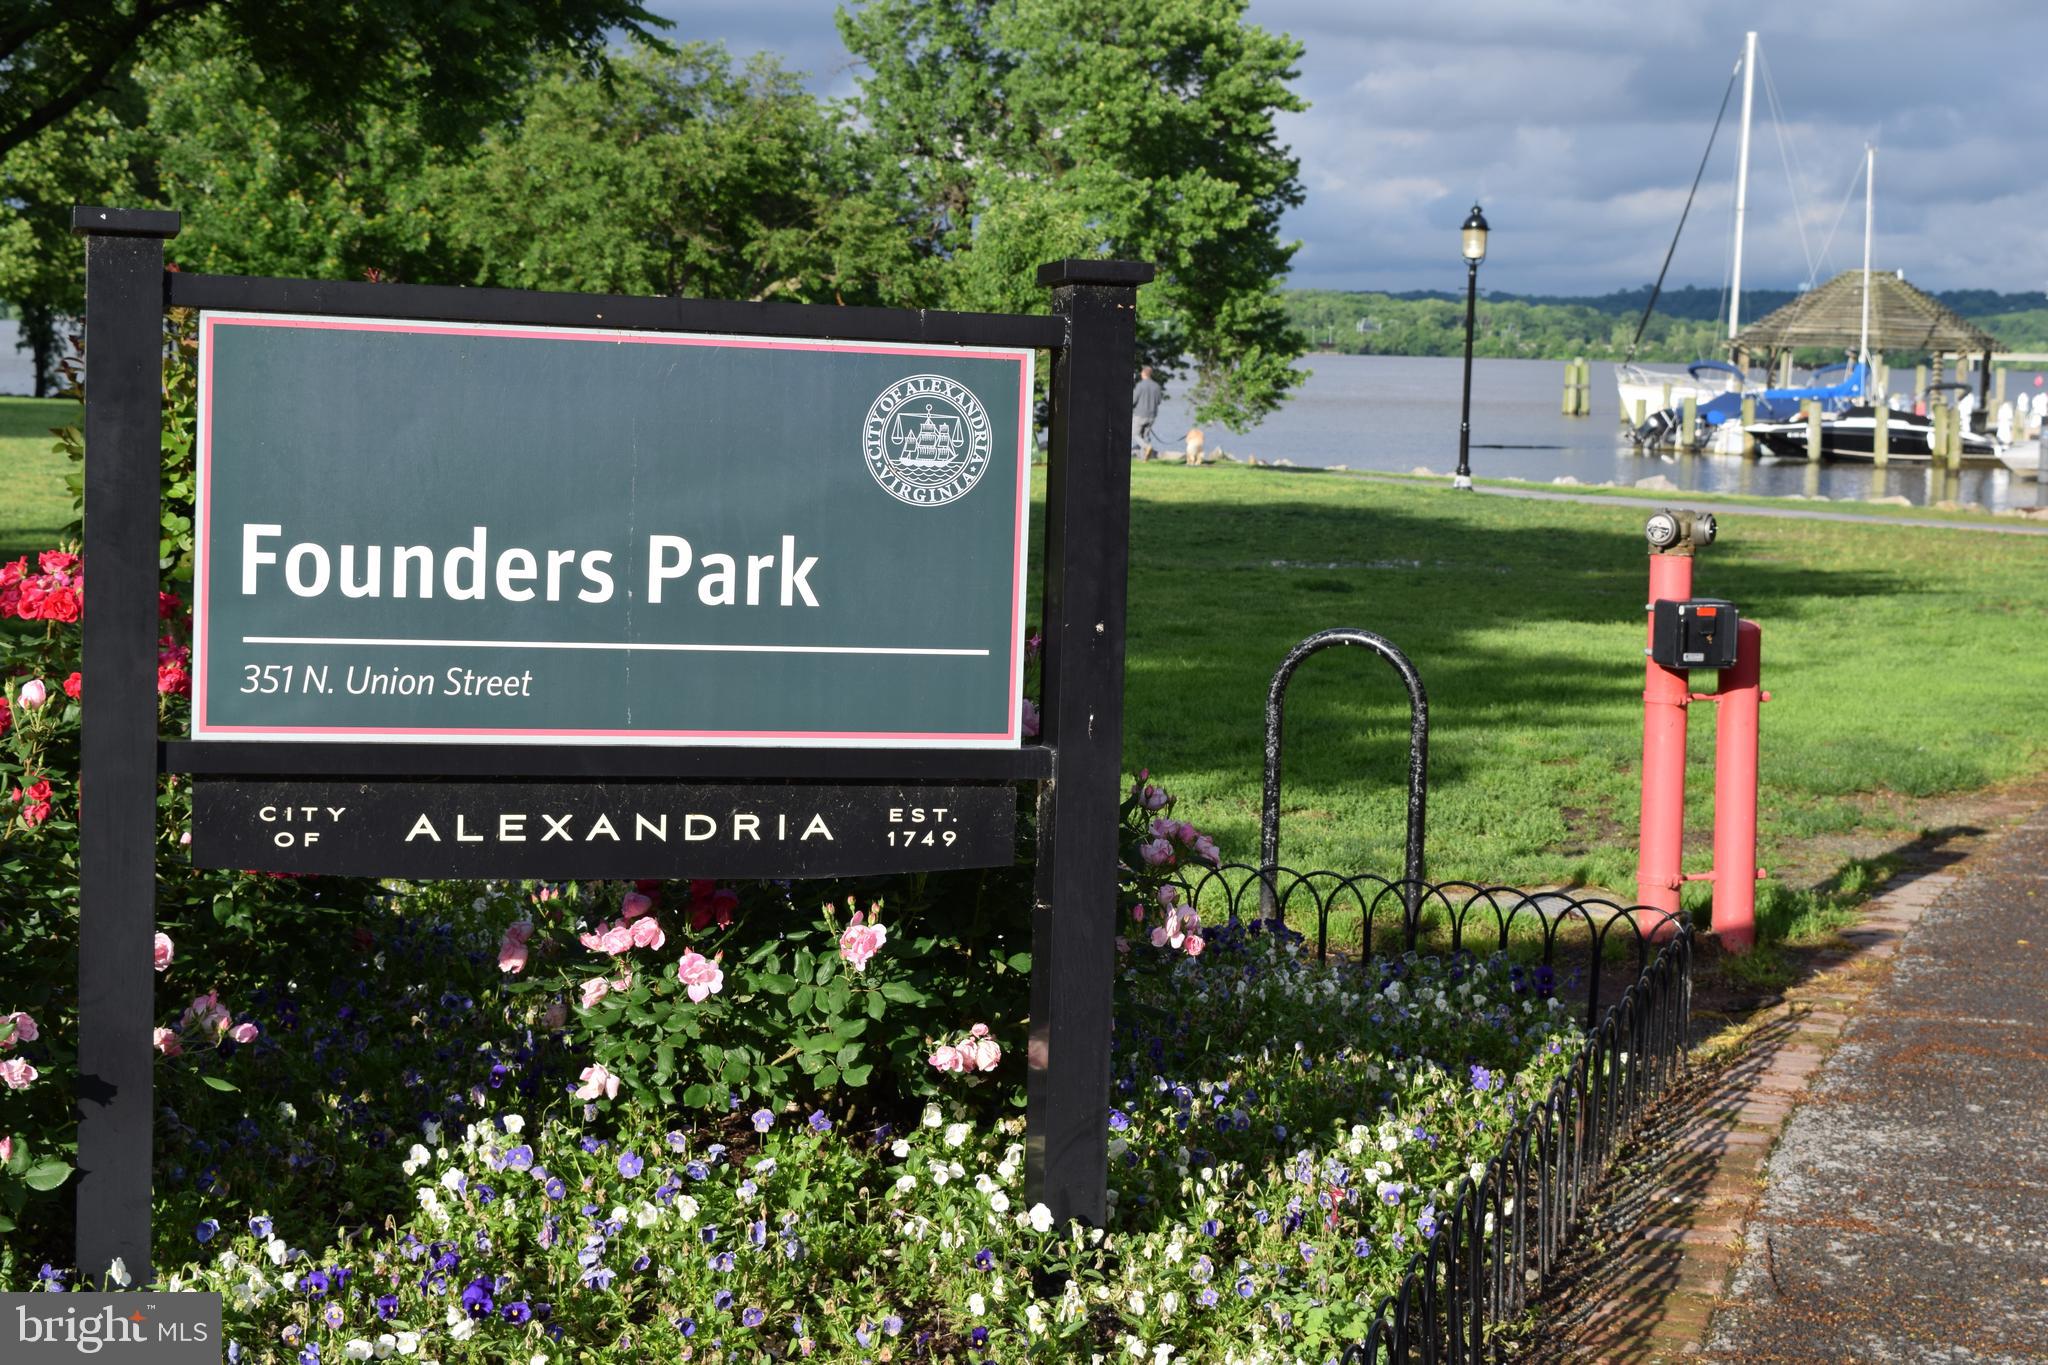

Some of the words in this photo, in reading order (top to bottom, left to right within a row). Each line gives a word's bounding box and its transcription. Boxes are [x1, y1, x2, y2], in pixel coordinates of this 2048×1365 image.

[867, 412, 886, 460] CITY
[880, 387, 903, 412] OF
[905, 379, 988, 464] ALEXANDRIA
[878, 465, 976, 502] VIRGINIA
[242, 523, 614, 603] Founders
[648, 534, 820, 607] Park
[240, 664, 293, 694] 351
[302, 665, 334, 694] N.
[346, 666, 435, 695] Union
[443, 667, 533, 696] Street
[259, 806, 346, 822] CITY
[404, 812, 834, 842] ALEXANDRIA
[889, 808, 958, 823] EST.
[274, 832, 320, 847] OF
[887, 831, 957, 847] 1749
